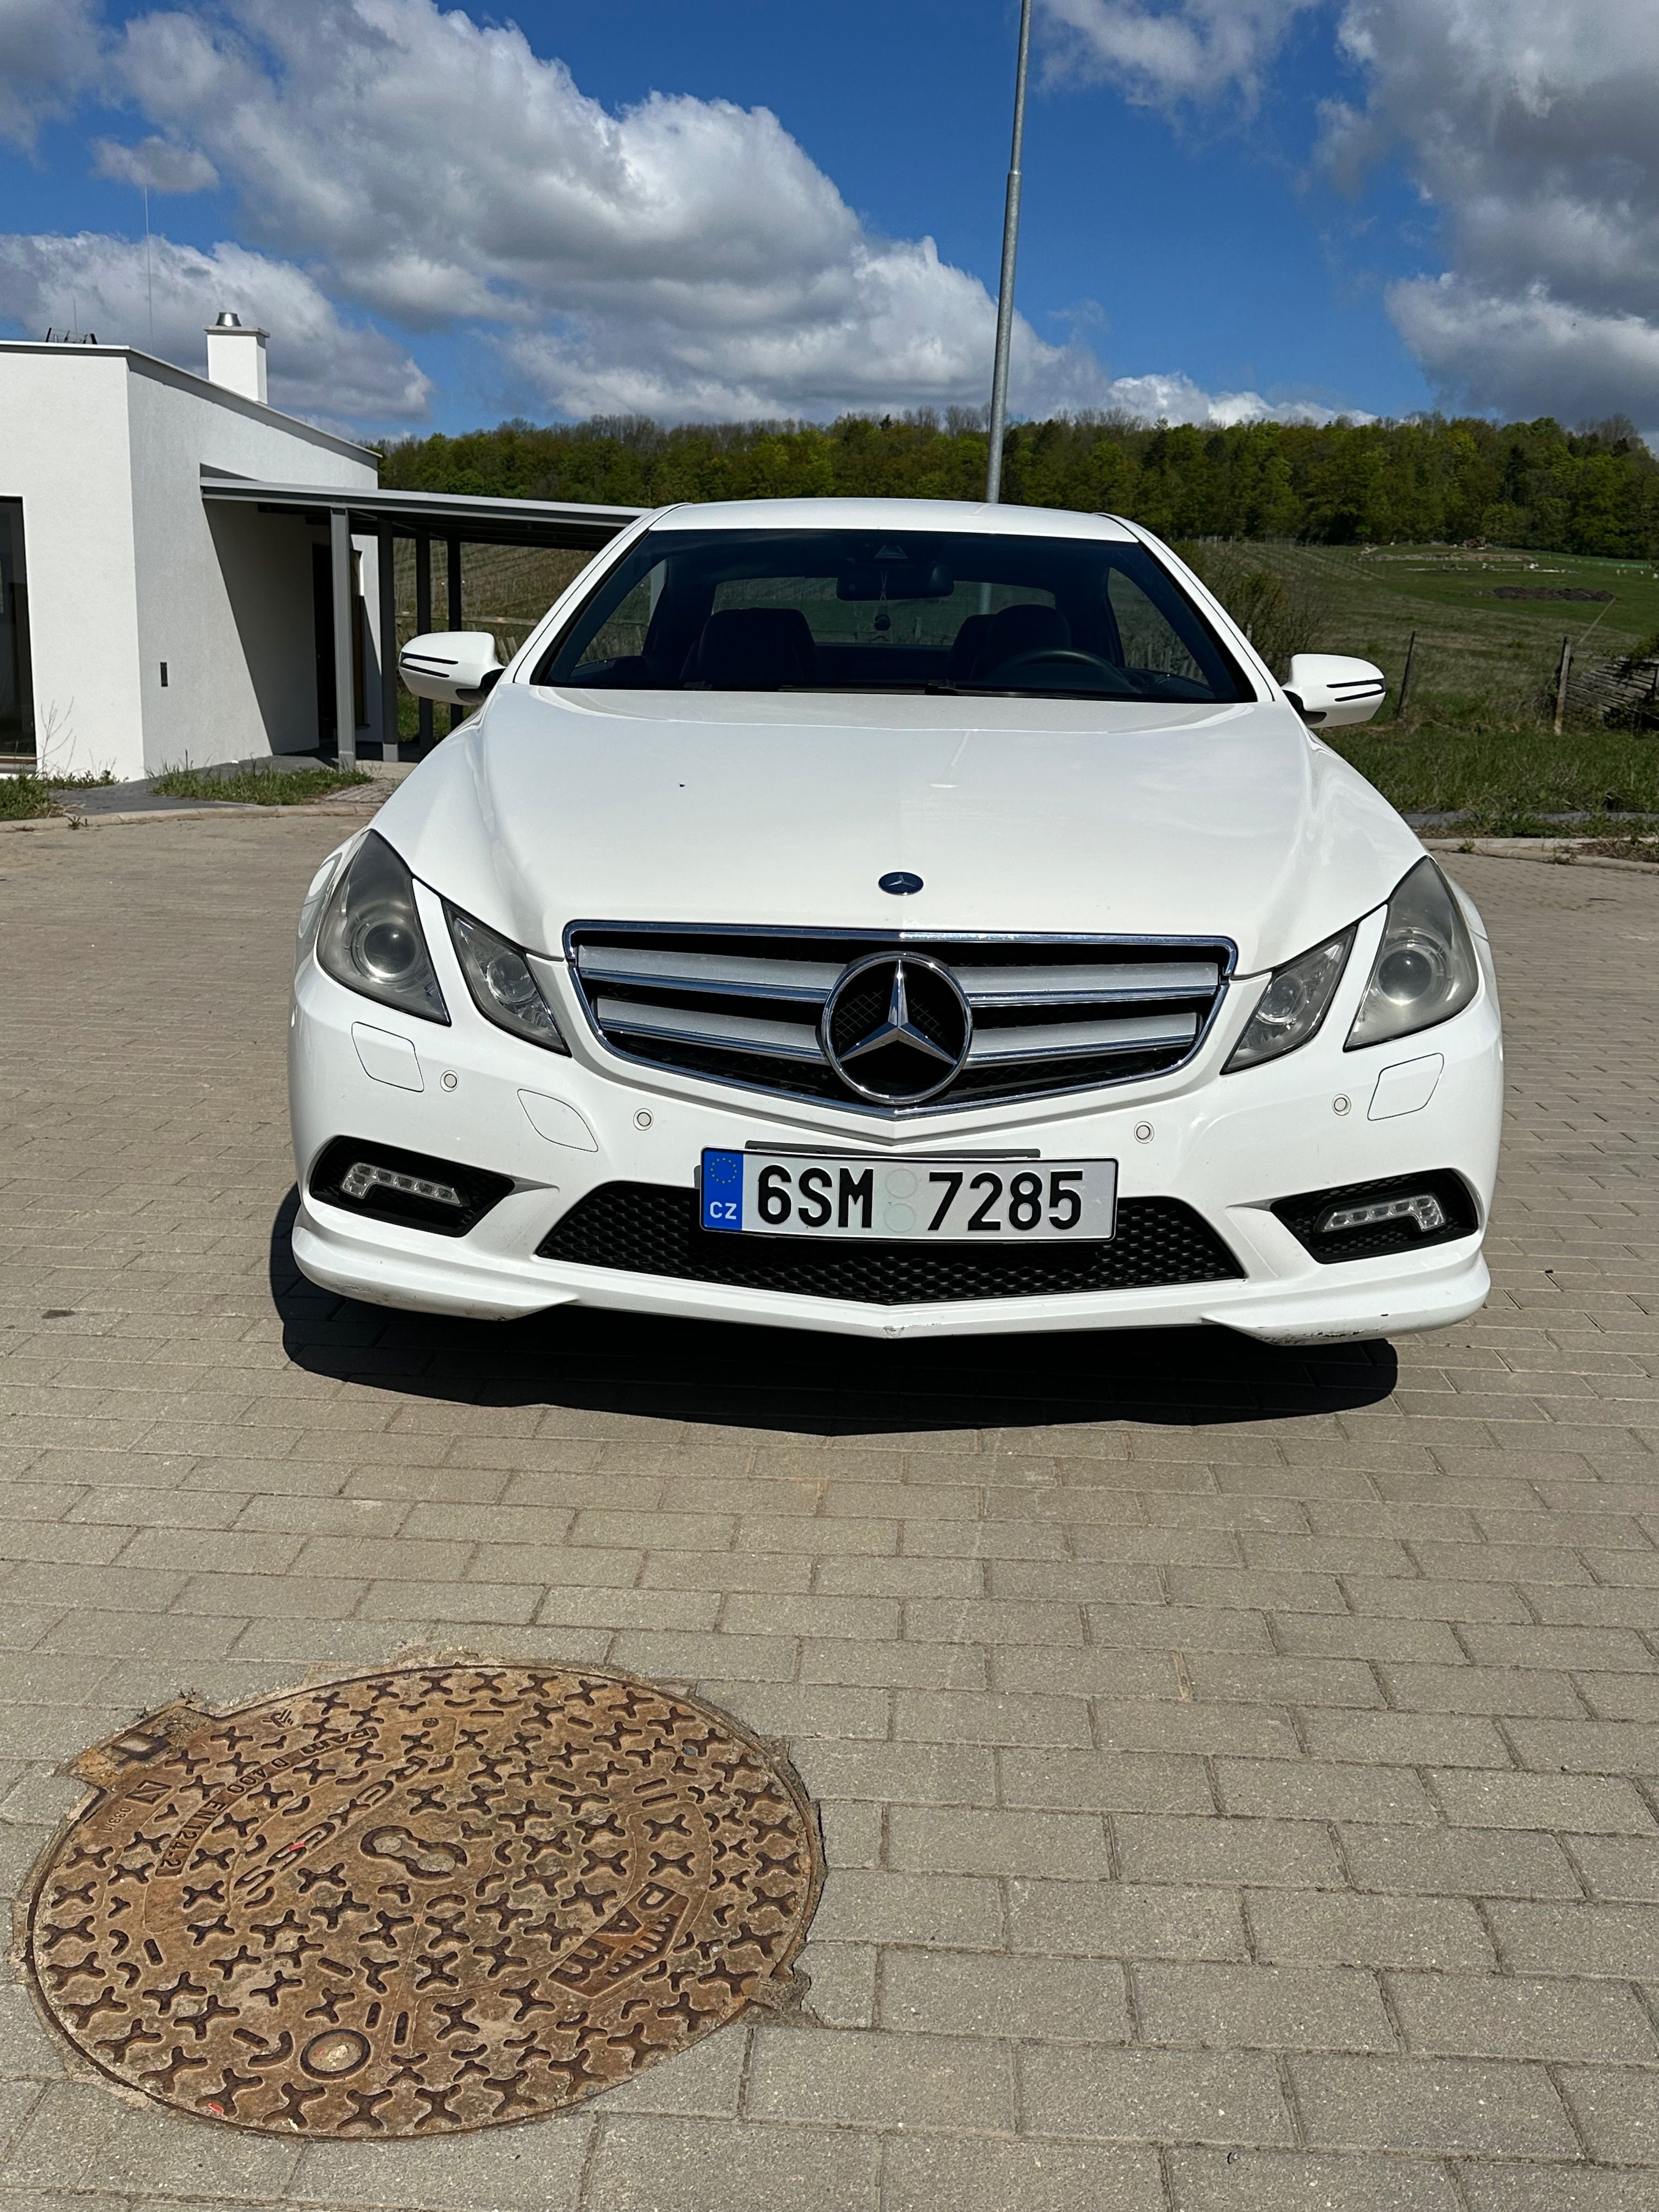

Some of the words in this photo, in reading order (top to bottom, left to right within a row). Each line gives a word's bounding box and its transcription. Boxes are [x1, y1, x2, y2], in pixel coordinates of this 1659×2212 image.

[757, 1164, 874, 1229] 6SM
[927, 1170, 1084, 1232] 7285
[709, 1201, 737, 1220] CZ
[271, 1757, 290, 1770] D
[226, 1768, 268, 1795] 400
[193, 1800, 228, 1821] EN
[233, 1755, 429, 1897] REXESS
